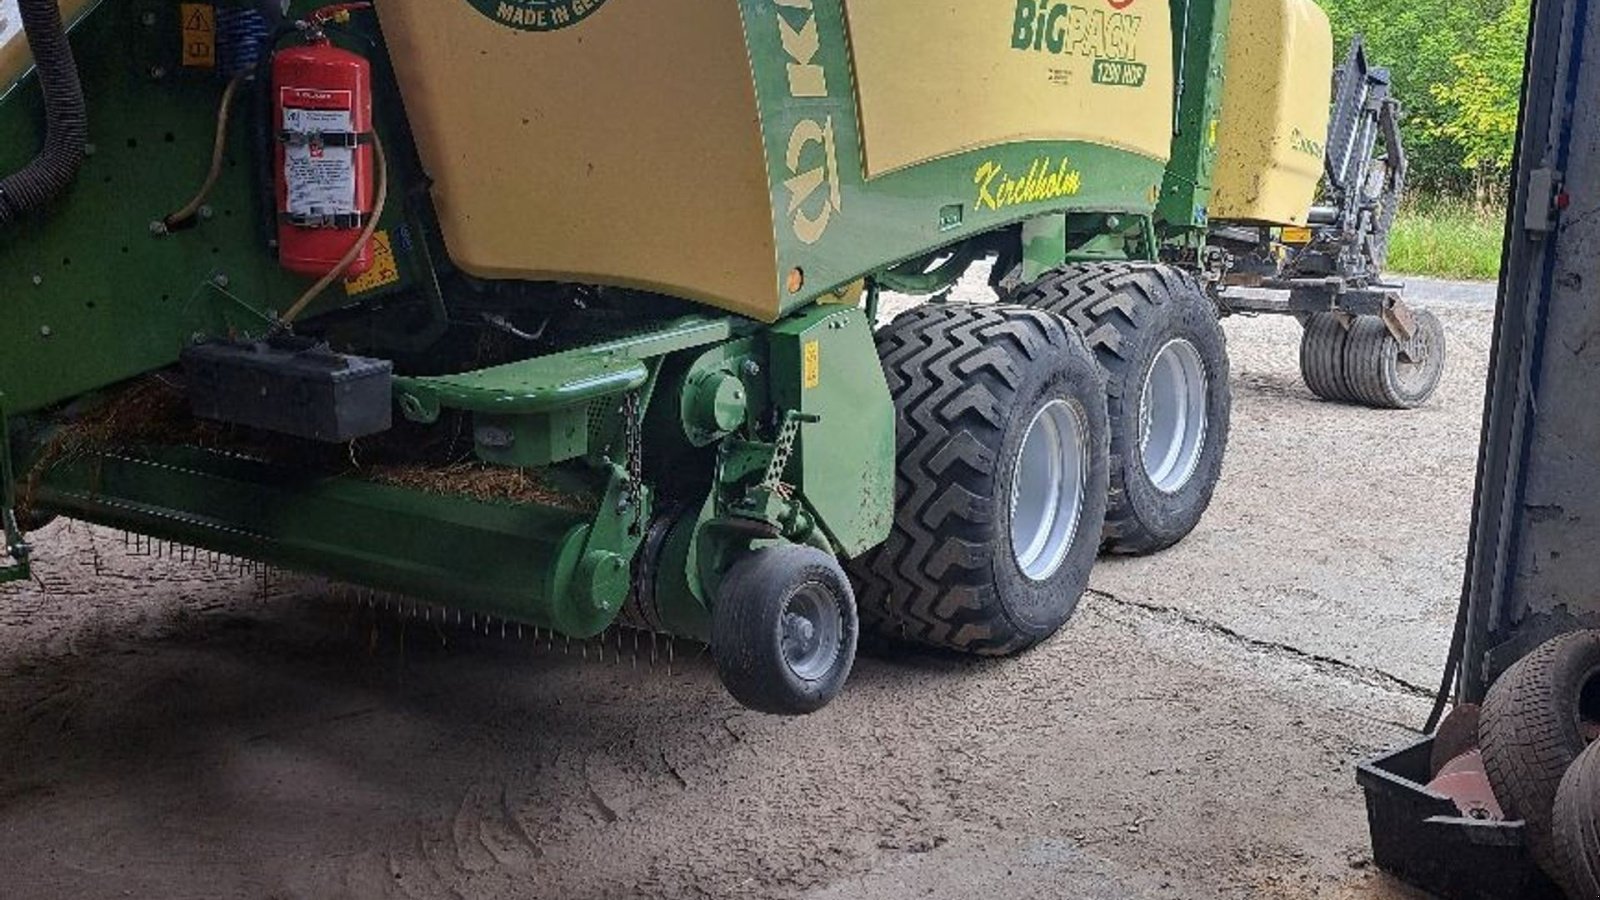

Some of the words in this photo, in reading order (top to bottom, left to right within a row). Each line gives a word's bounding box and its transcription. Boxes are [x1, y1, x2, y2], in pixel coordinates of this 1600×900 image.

[496, 3, 548, 26] MADE
[550, 6, 570, 24] IN
[974, 156, 1081, 211] Kirchholm
